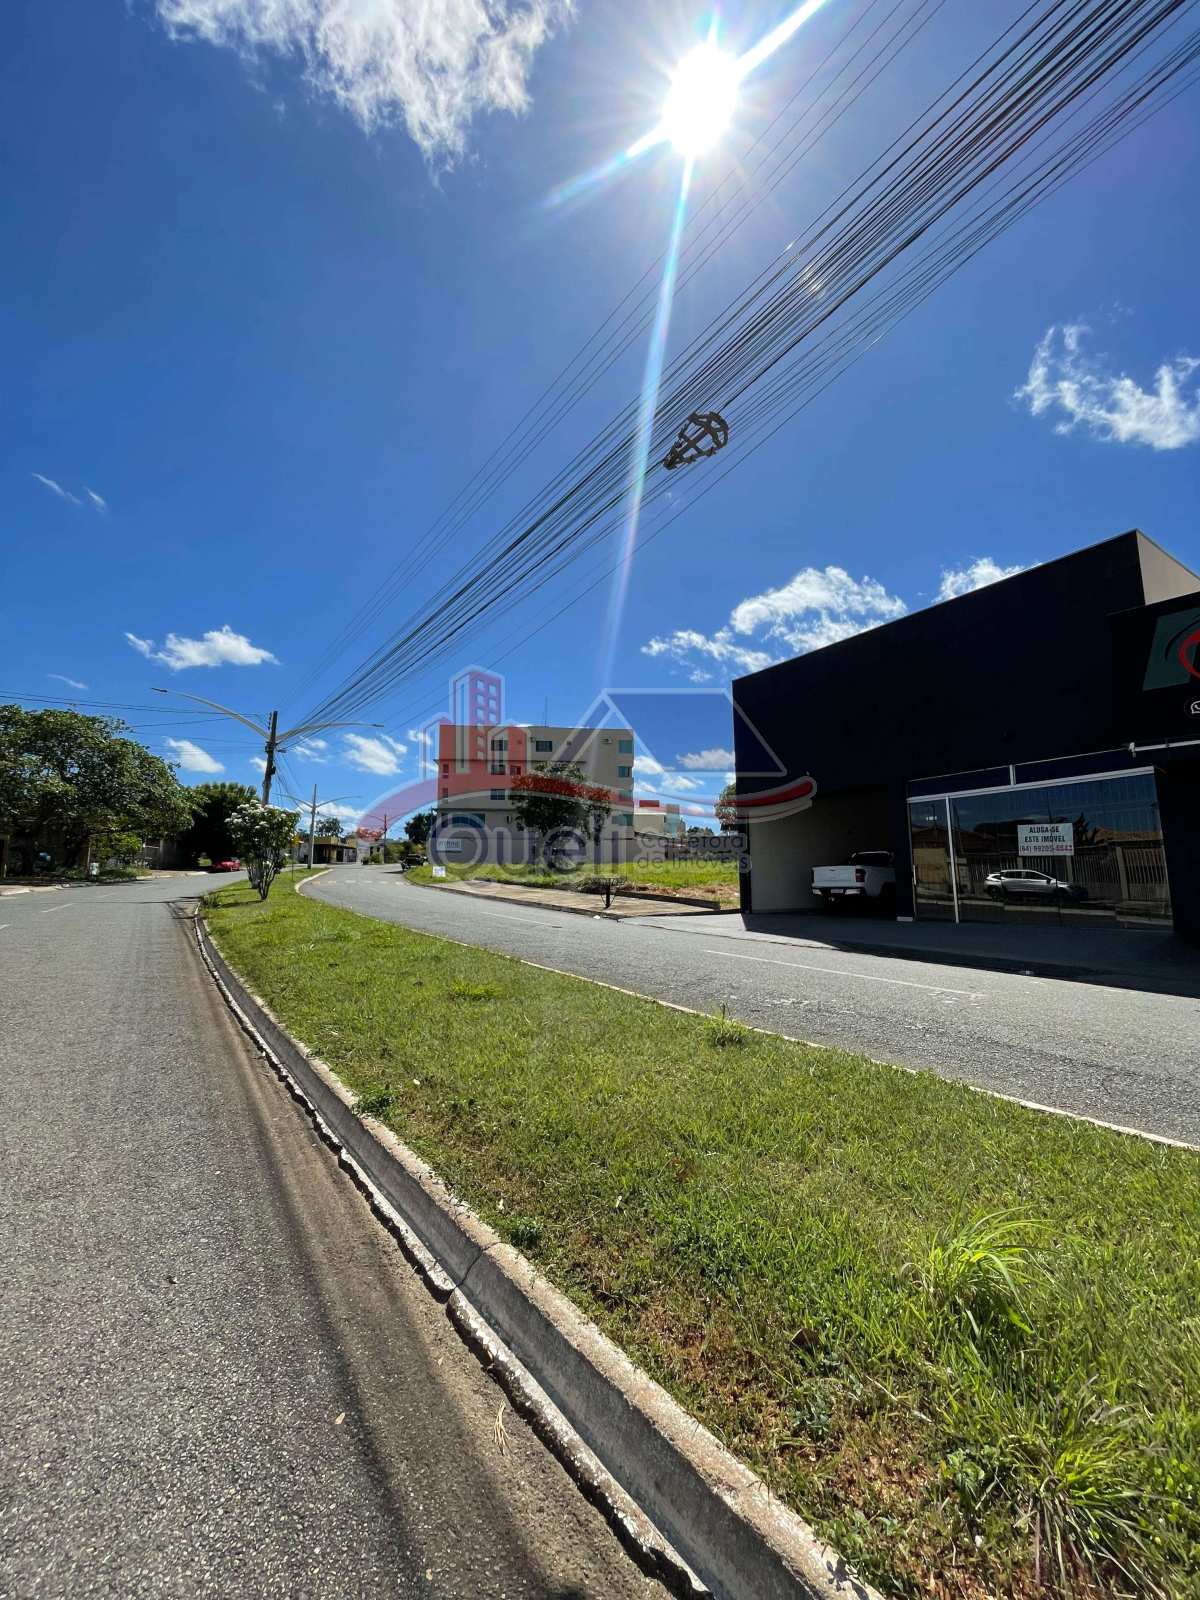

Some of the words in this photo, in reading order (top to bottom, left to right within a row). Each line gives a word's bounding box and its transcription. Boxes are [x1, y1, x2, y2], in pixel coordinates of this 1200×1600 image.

[1029, 825, 1060, 834] ALUGA-SE
[1024, 835, 1040, 843] ESTE
[1041, 833, 1066, 843] IMÓVEL
